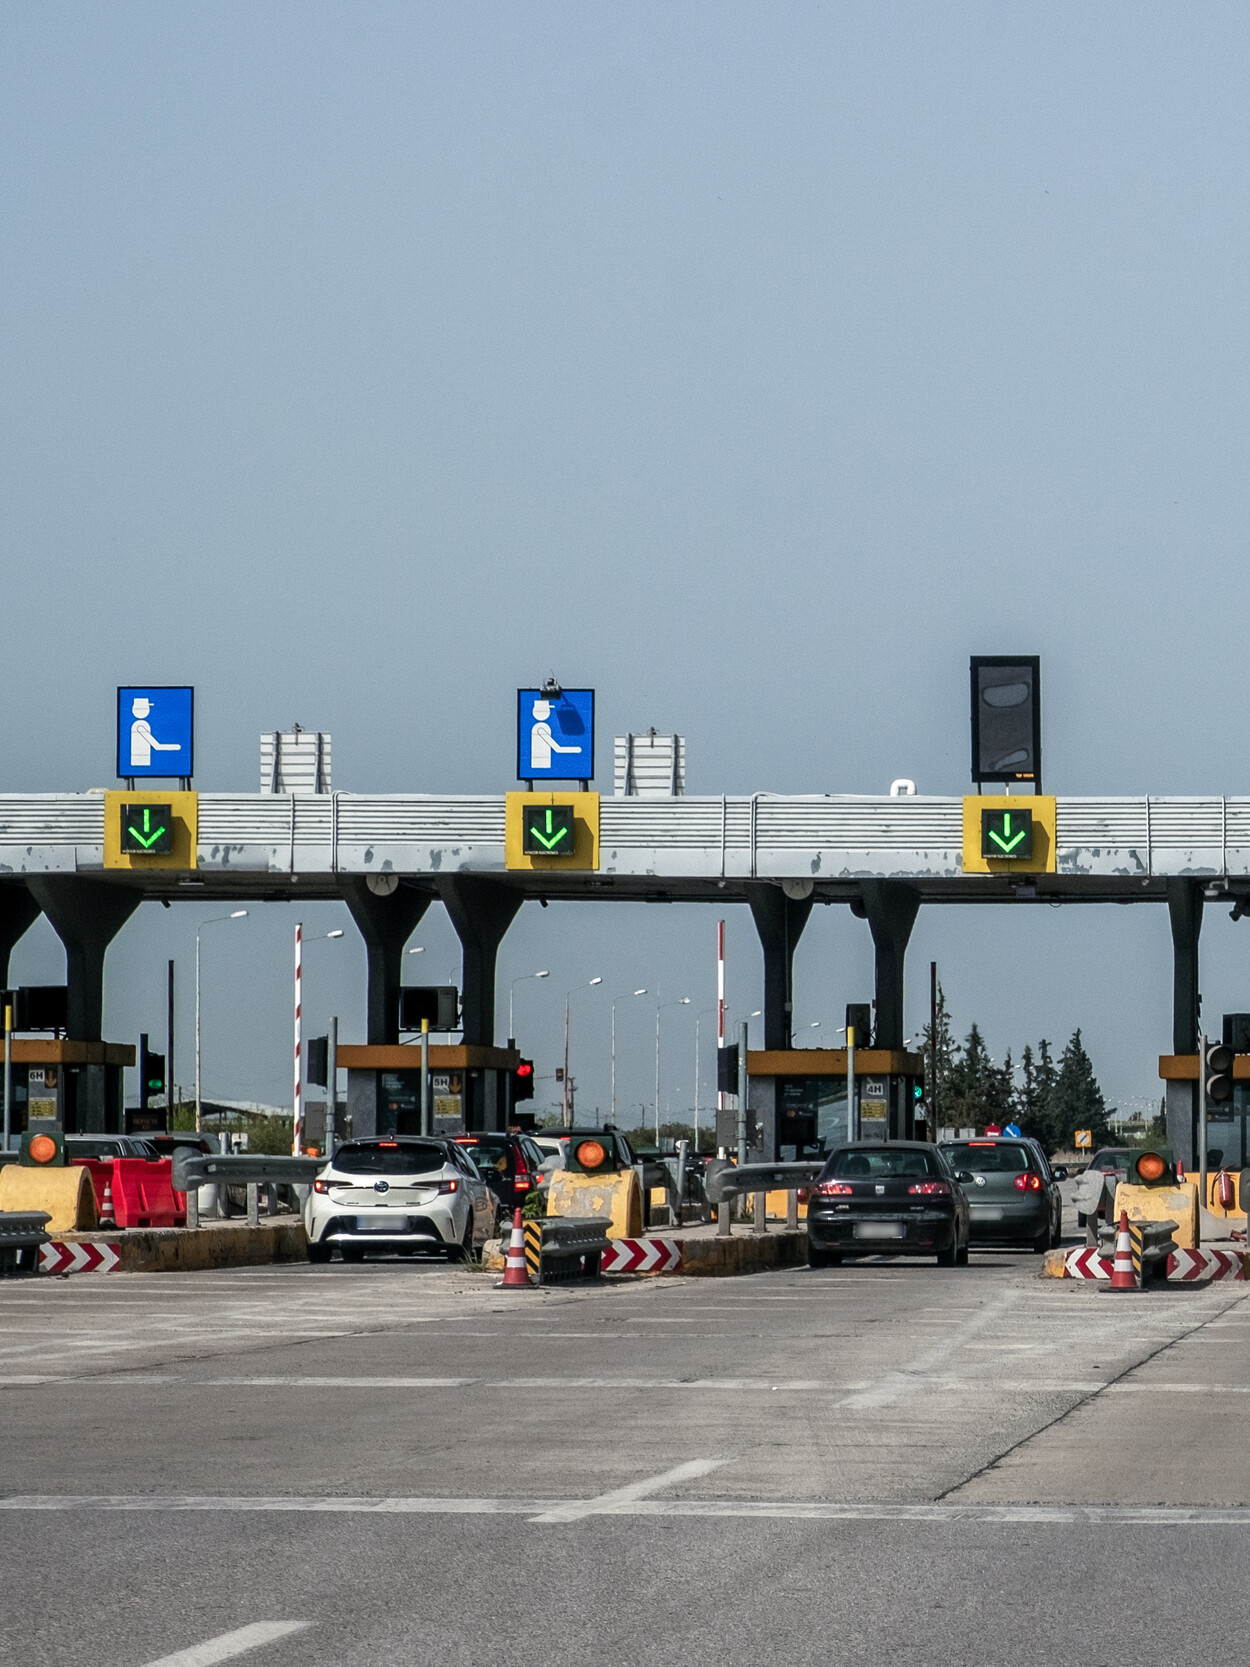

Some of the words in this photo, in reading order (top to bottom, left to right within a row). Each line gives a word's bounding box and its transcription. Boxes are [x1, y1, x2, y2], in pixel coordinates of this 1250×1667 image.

[29, 1071, 43, 1081] 6H
[434, 1077, 448, 1087] 5H
[867, 1084, 881, 1093] 4H
